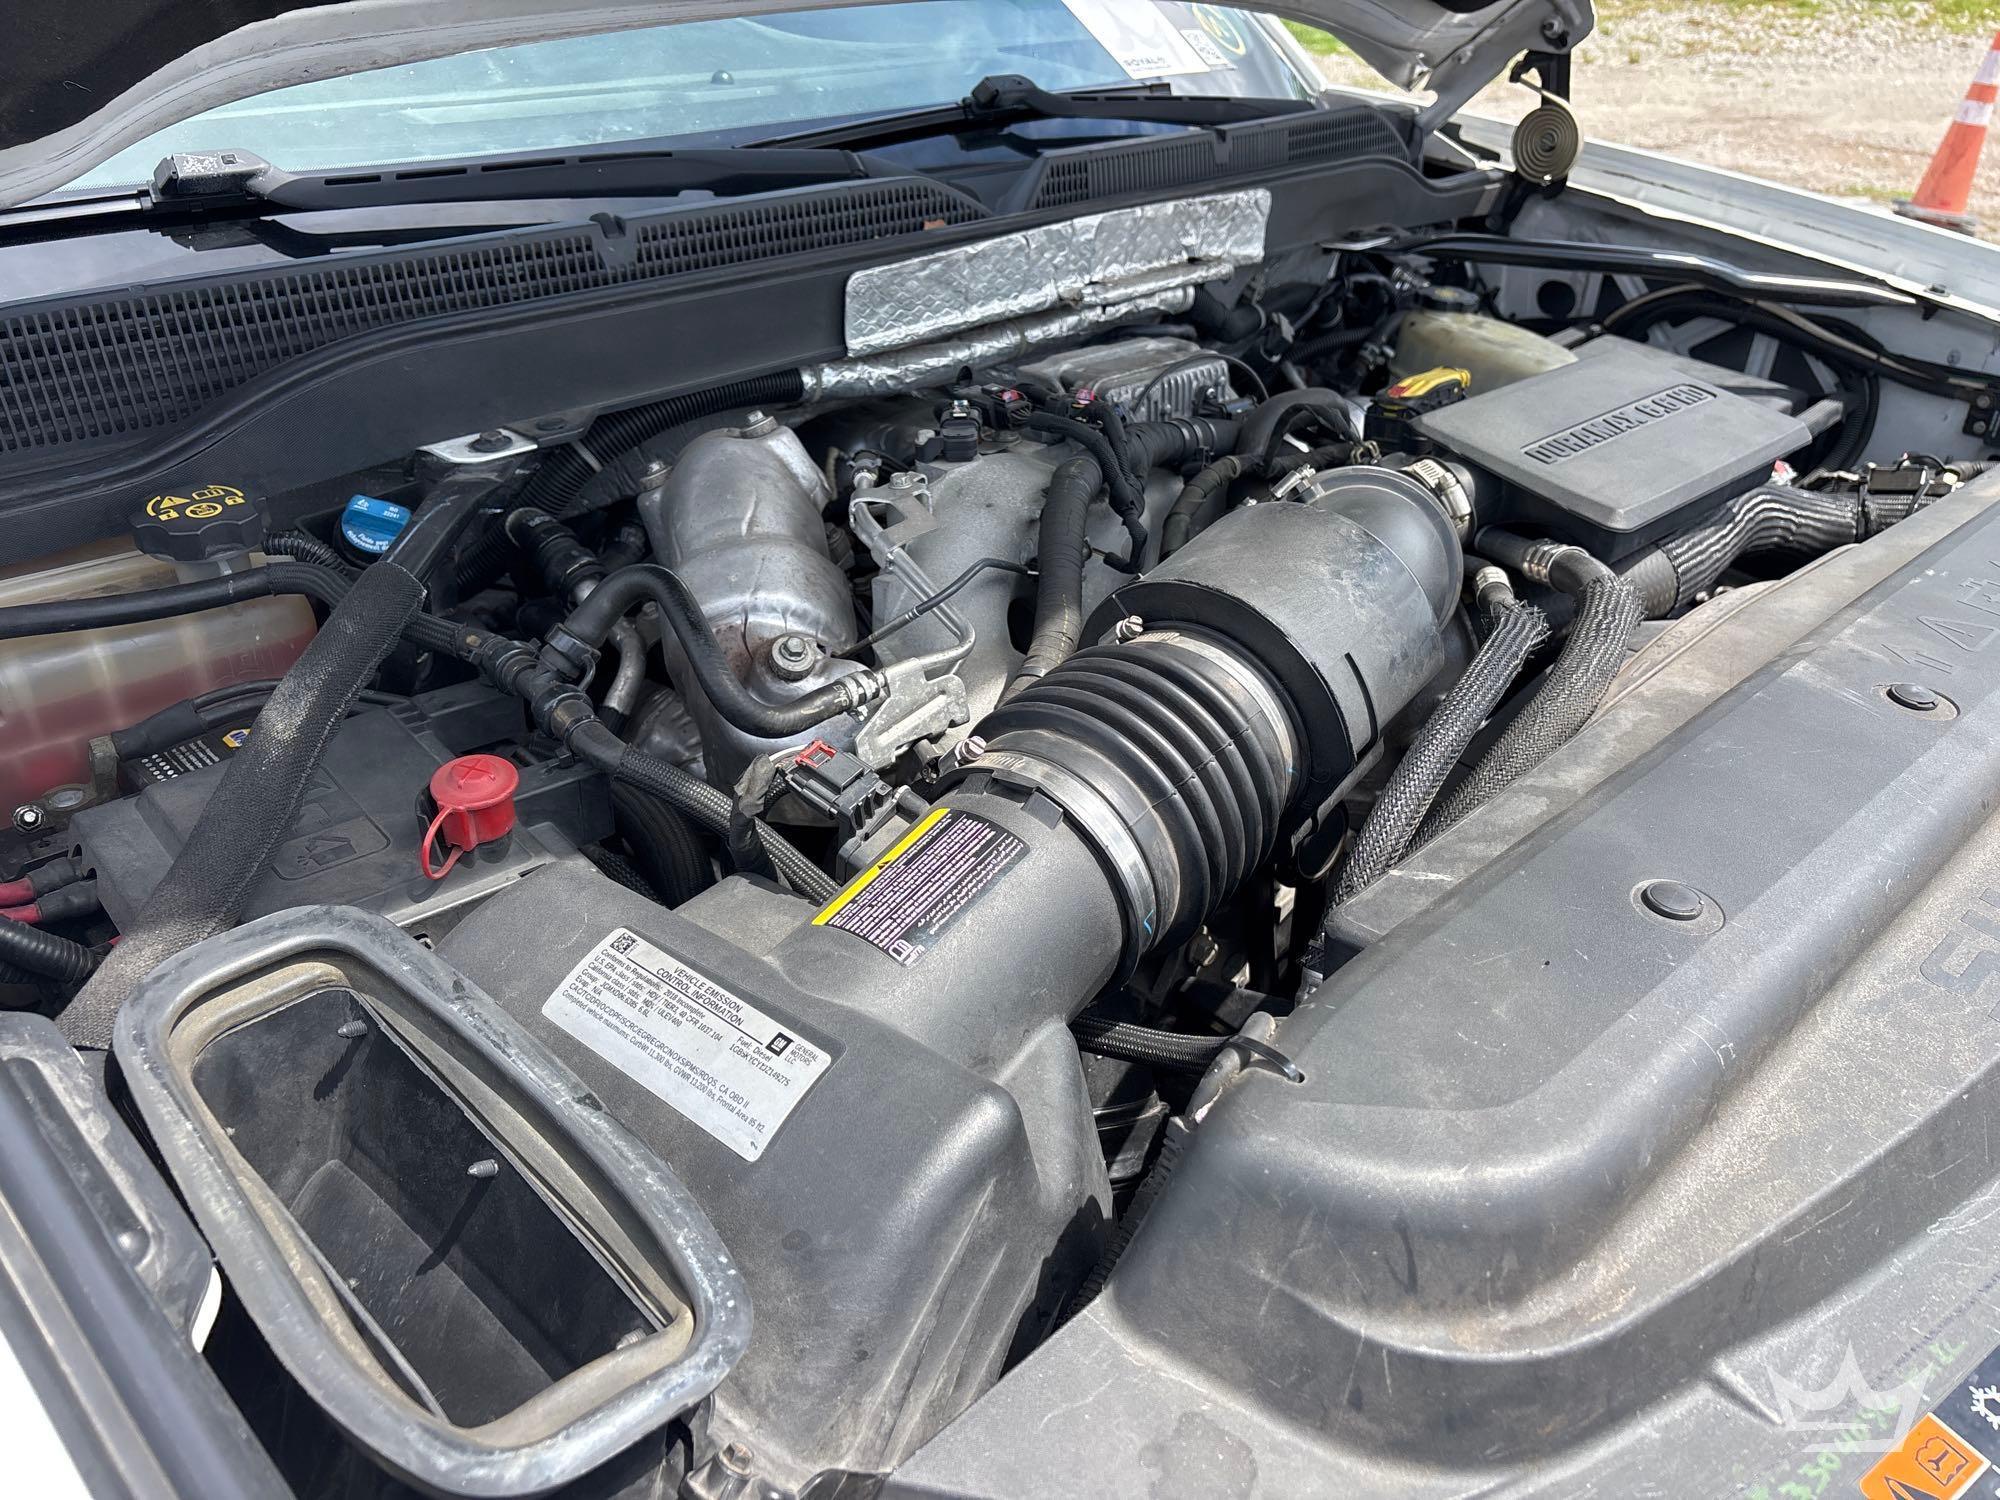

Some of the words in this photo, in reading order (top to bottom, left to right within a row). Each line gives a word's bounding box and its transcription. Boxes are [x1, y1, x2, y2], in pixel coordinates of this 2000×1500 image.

[1524, 410, 1648, 465] DURAMAX
[586, 960, 614, 981] California
[610, 976, 627, 989] class
[599, 948, 627, 968] Conforms
[623, 963, 633, 972] to
[628, 966, 664, 993] Regulations:
[662, 987, 679, 1001] 2018
[603, 961, 618, 973] EPA
[614, 968, 631, 982] class
[654, 966, 694, 994] CONTROL
[689, 988, 745, 1026] INFORMATION
[672, 965, 707, 990] VEHICLE
[704, 985, 744, 1013] EMISSION
[559, 988, 589, 1011] Completed
[584, 1005, 605, 1022] vehicle
[671, 1065, 692, 1082] GVWR
[714, 1094, 738, 1113] Frontal
[733, 1107, 751, 1122] Area
[735, 1035, 754, 1050] Fuel:
[751, 1045, 773, 1063] Diesel
[783, 1053, 797, 1065] LLC
[788, 1048, 813, 1067] MOTORS
[793, 1042, 820, 1062] GENERAL
[717, 1083, 731, 1095] CA
[727, 1090, 745, 1105] OBD
